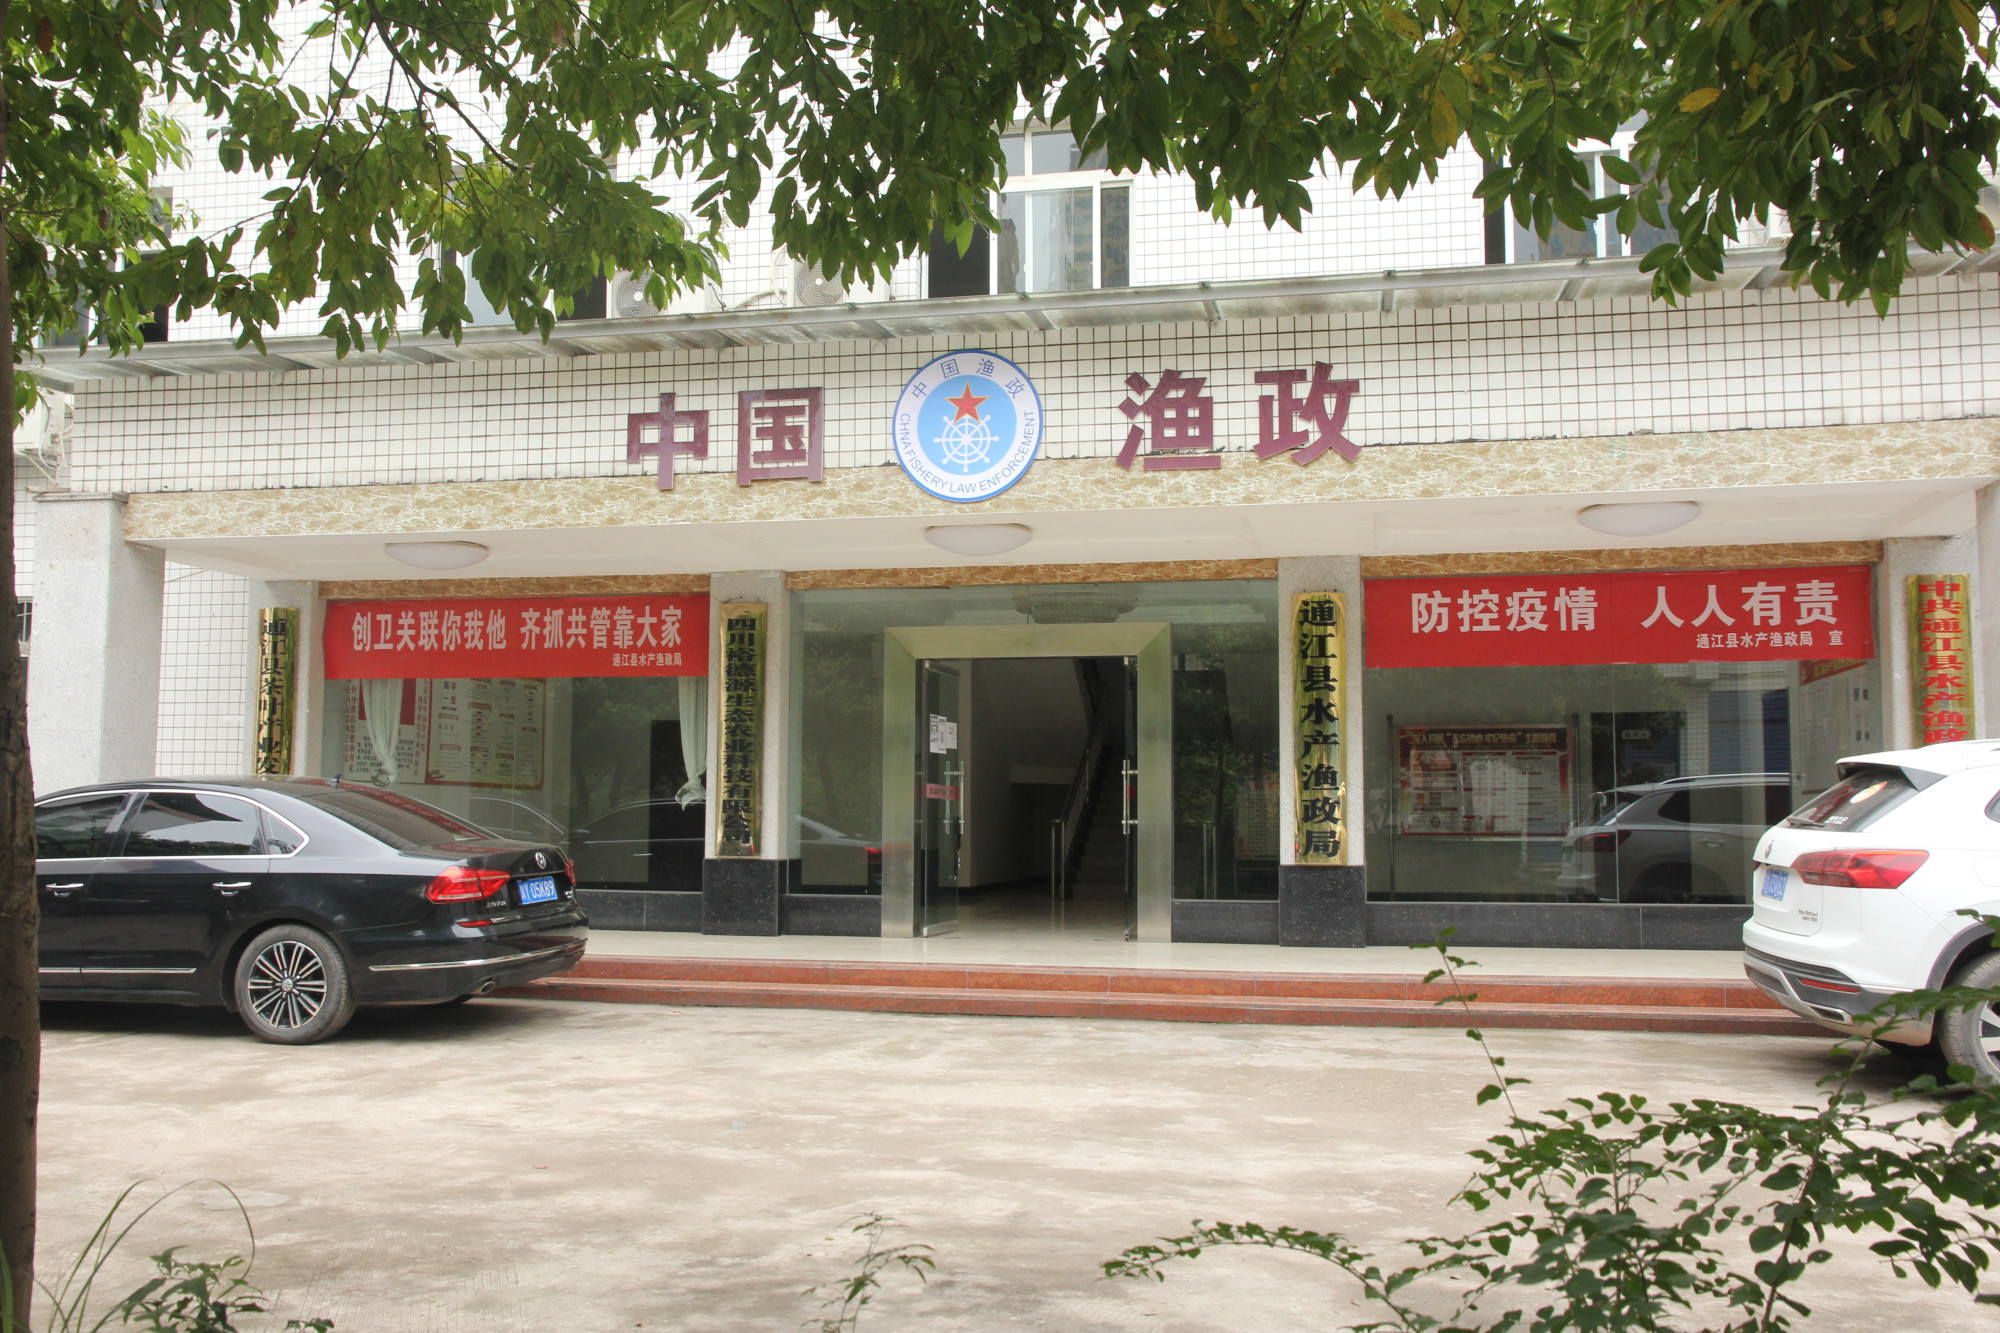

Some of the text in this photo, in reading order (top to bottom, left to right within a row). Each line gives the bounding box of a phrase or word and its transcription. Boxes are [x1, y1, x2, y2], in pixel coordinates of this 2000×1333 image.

[912, 358, 1025, 399] 中国渔政
[627, 361, 1362, 489] 中国 渔政
[905, 449, 949, 490] FISHERY
[949, 482, 977, 494] LAW
[979, 410, 1036, 492] ENFORCEMENT
[351, 605, 682, 652] 创卫关联你我他 齐抓共管靠大家
[1411, 579, 1839, 634] 防控疫情 人人有责
[612, 652, 683, 667] 通江县水产渔政局
[1696, 630, 1844, 649] 通江县水产渔政局 宣
[1298, 599, 1342, 858] 通江县水产渔政局
